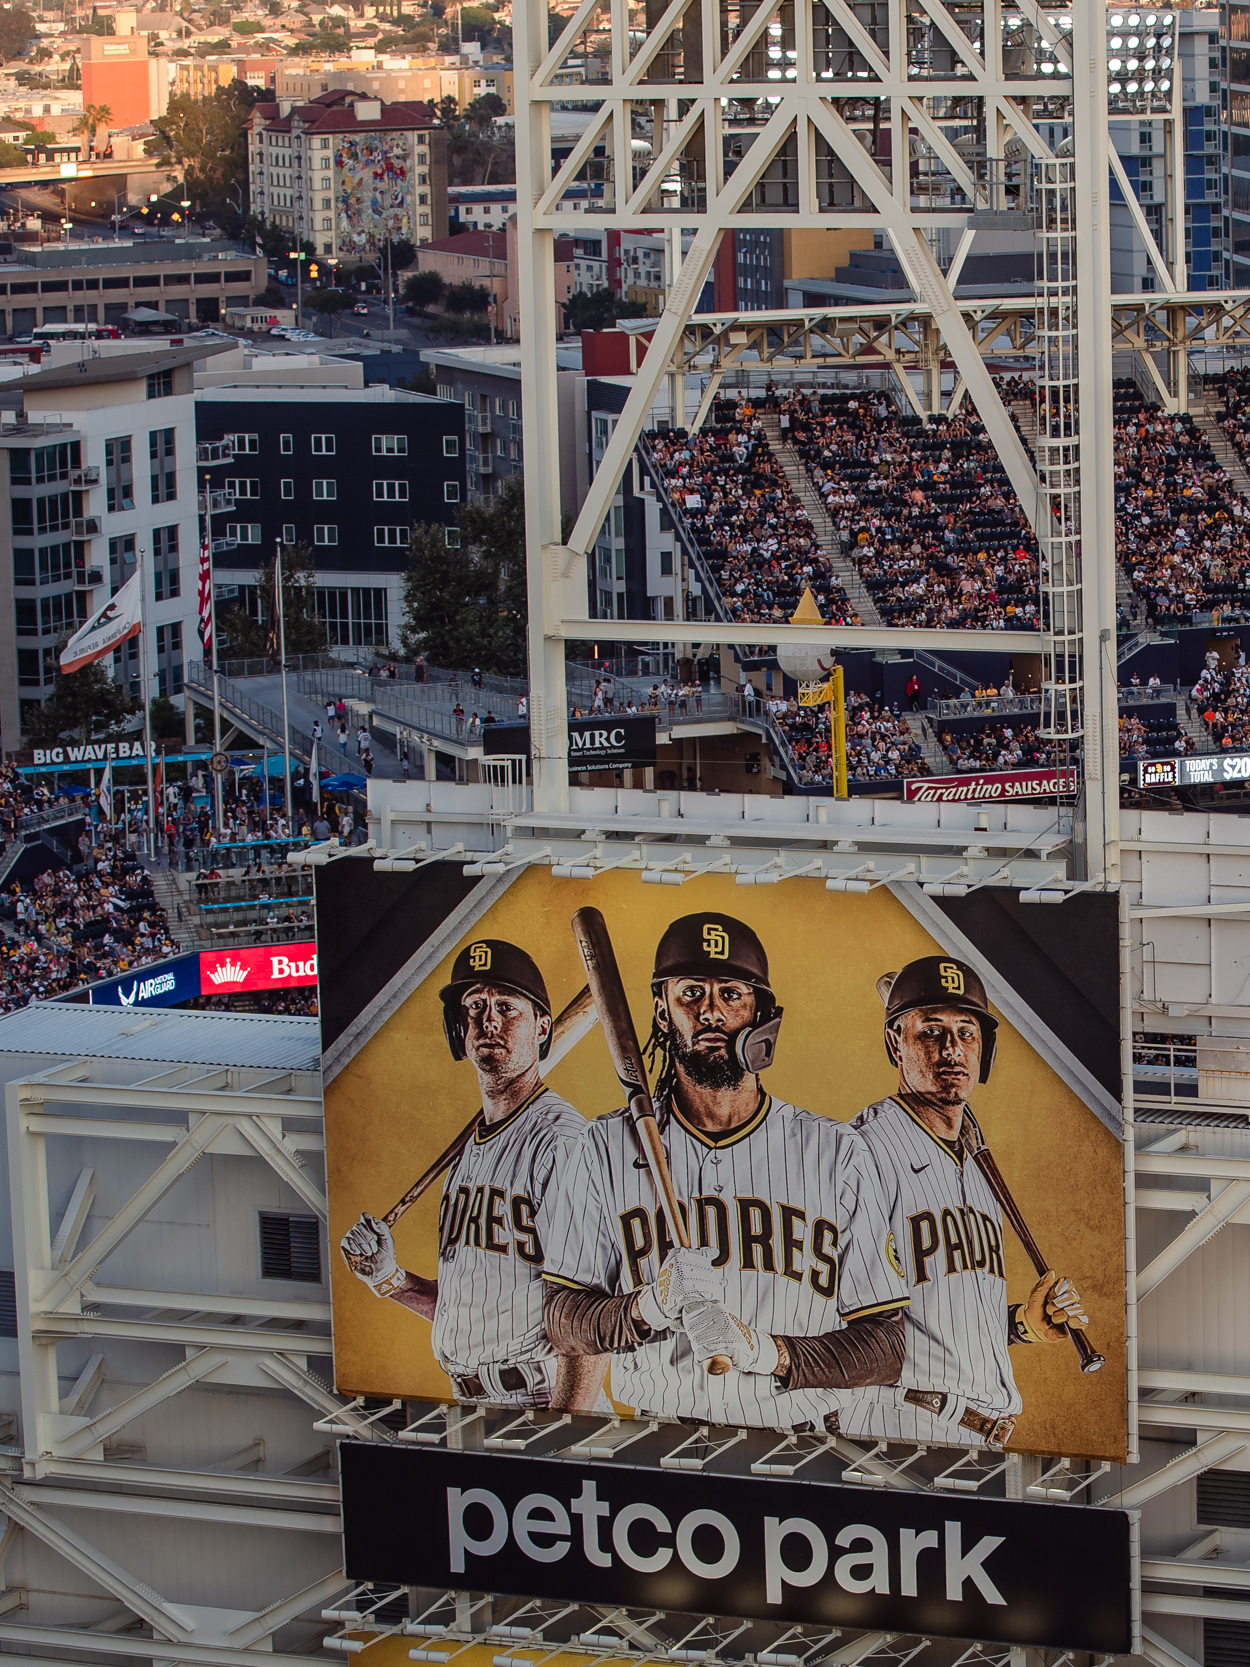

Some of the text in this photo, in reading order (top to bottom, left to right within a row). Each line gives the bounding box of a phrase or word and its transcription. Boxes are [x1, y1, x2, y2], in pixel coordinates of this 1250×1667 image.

[571, 728, 625, 749] MRC
[33, 747, 64, 765] BIG
[66, 743, 117, 762] WAVE
[118, 740, 156, 758] BAR
[1184, 758, 1218, 772] TODAY'S
[1190, 770, 1214, 783] TOTAL
[1145, 772, 1173, 783] RAFFLE
[910, 779, 1002, 802] Tarantino
[270, 954, 318, 979] Bud
[138, 972, 175, 1001] AIR NATIONAL
[154, 979, 176, 994] GUARD
[617, 1194, 839, 1301] PADRES
[446, 1479, 1008, 1606] petco park
